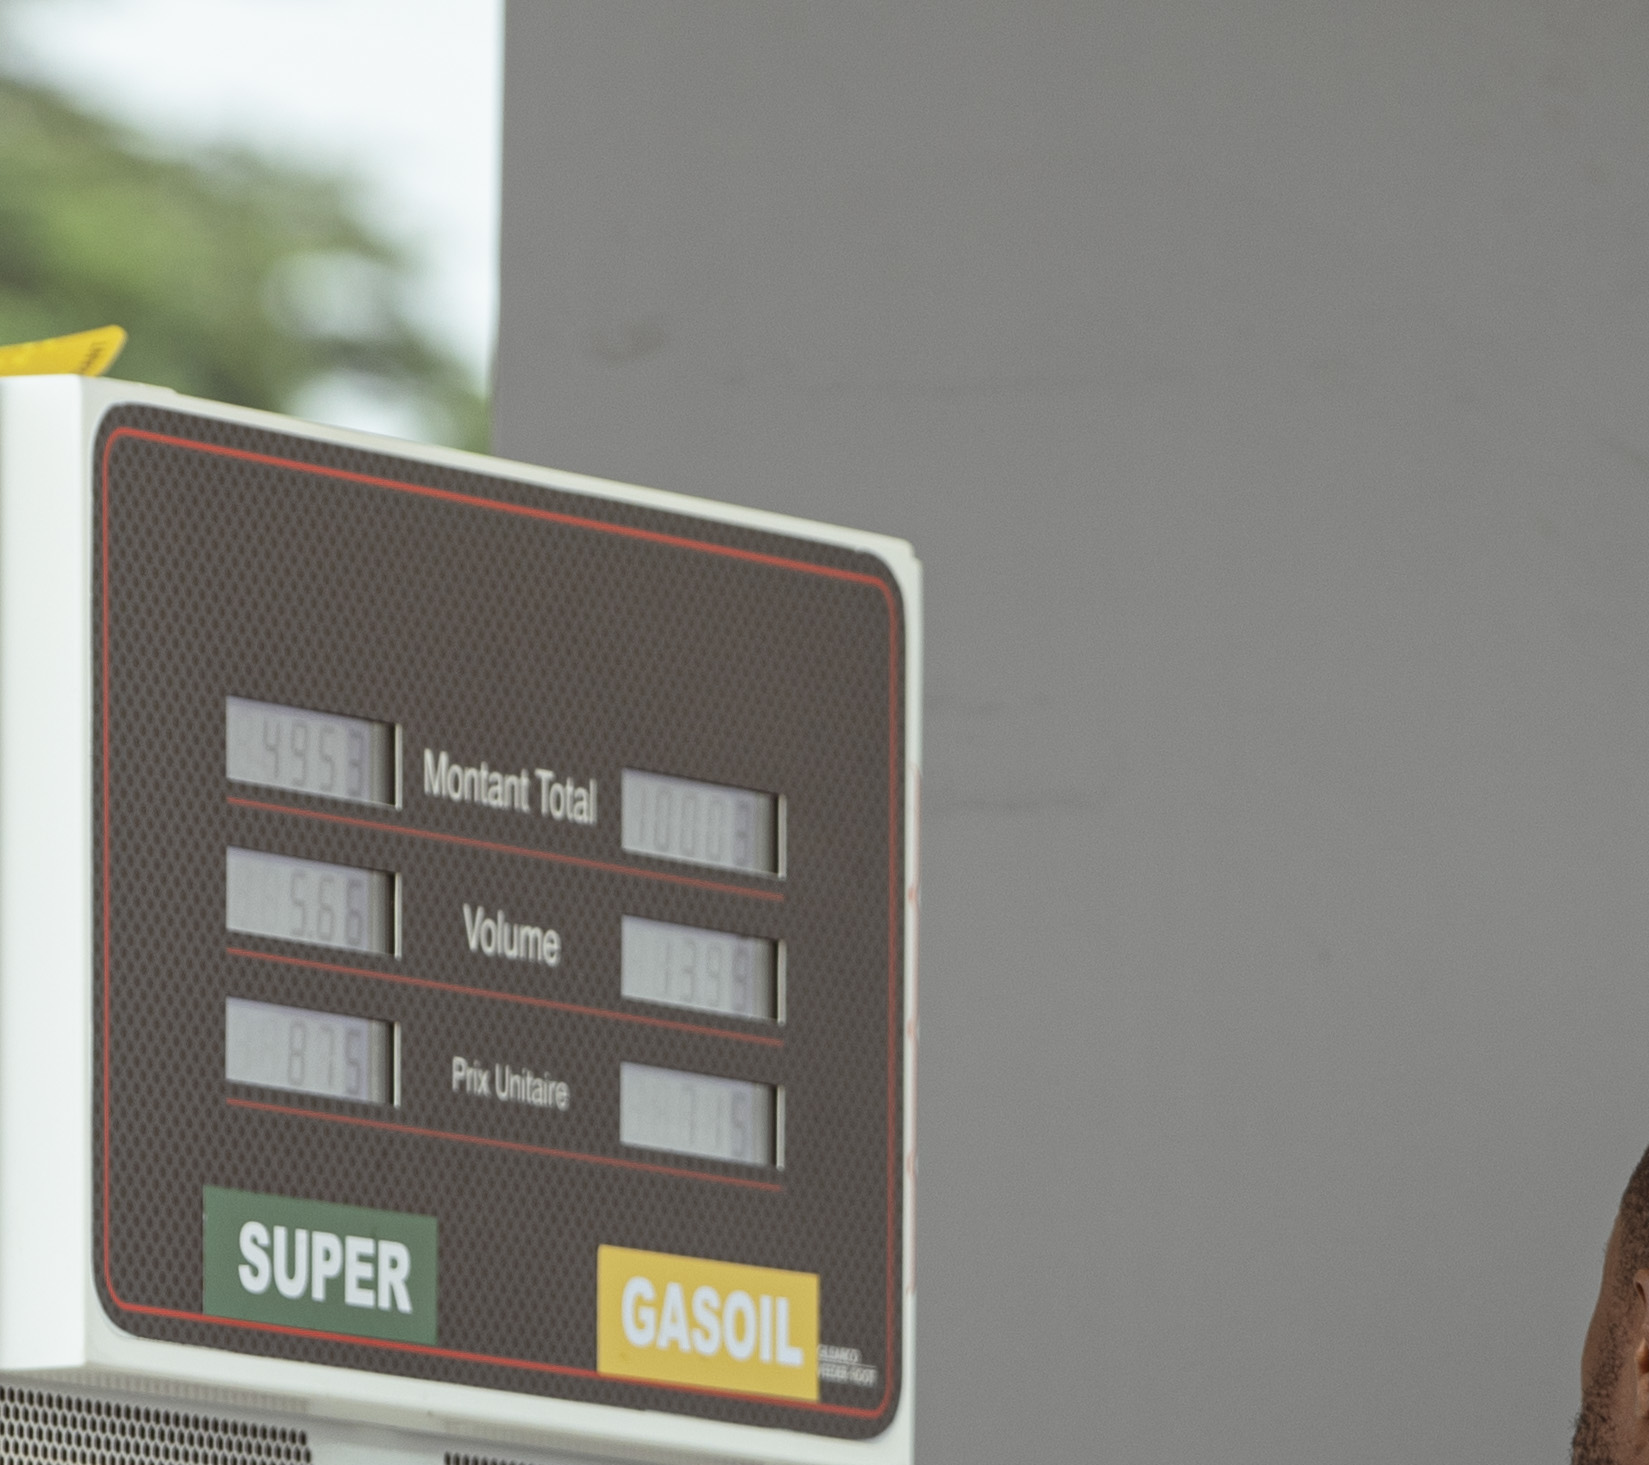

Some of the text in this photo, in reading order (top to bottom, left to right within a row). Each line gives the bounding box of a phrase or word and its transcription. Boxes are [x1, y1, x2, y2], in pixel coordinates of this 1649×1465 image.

[423, 748, 598, 825] Montant Total
[462, 902, 562, 967] Volume
[452, 1055, 571, 1112] Prix Unitaire
[237, 1220, 413, 1315] SUPER
[620, 1275, 805, 1367] GASOIL
